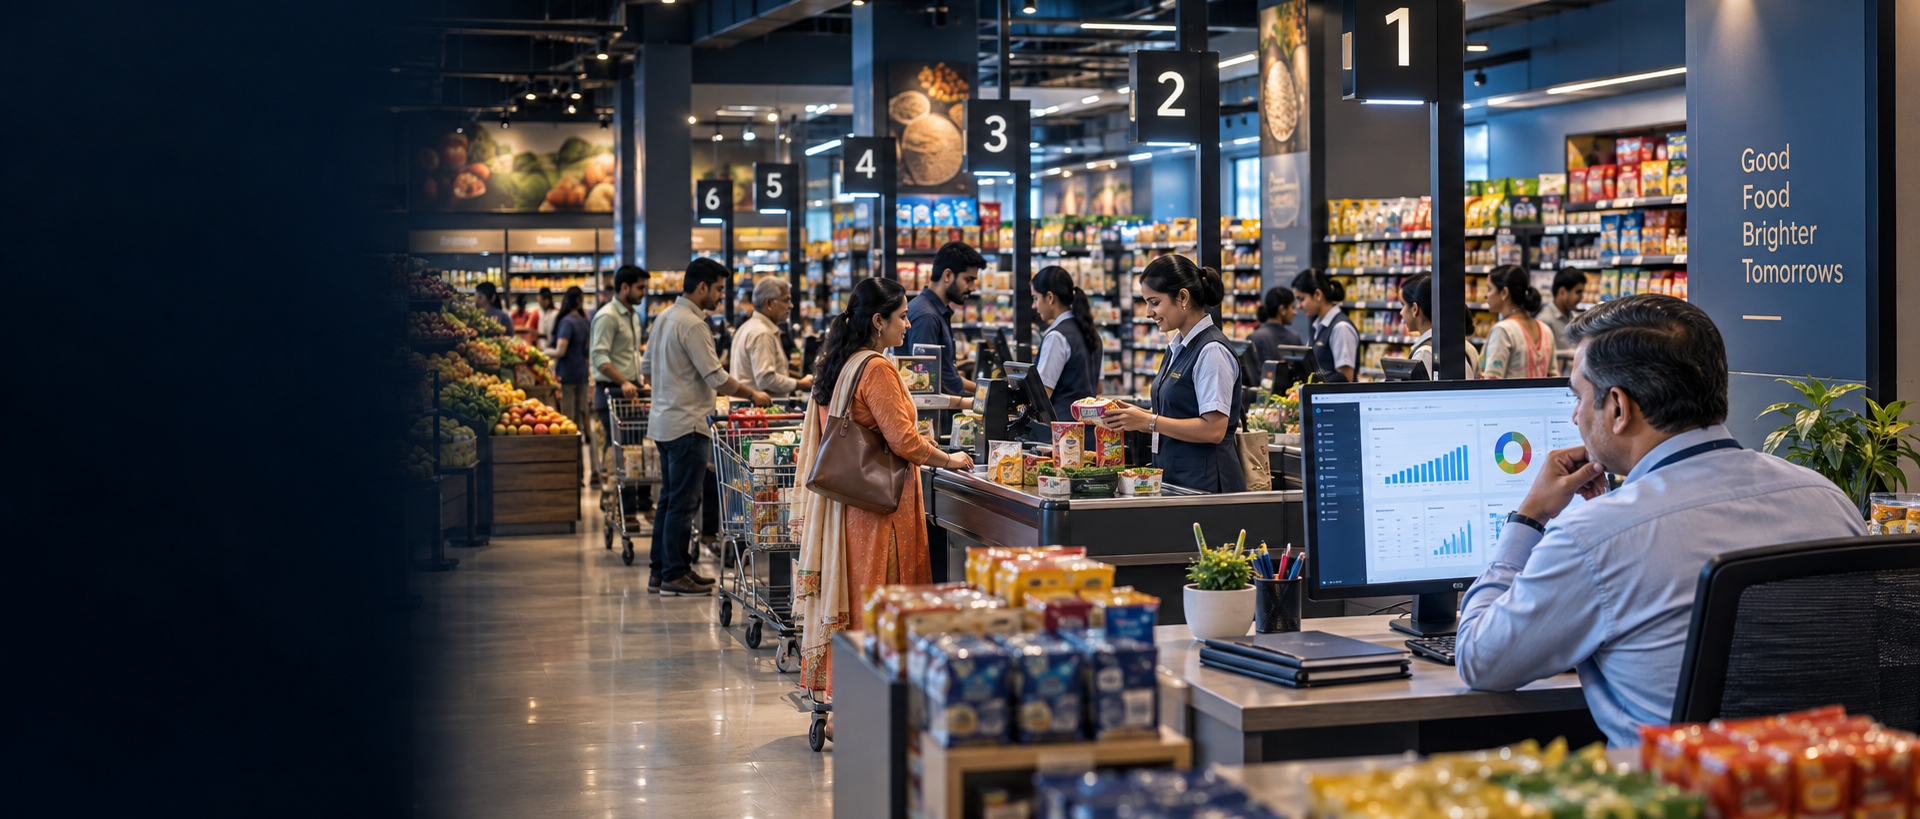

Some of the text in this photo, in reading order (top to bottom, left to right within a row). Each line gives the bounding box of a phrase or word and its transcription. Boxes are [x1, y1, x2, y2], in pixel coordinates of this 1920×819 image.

[1385, 7, 1410, 67] 1
[1157, 70, 1186, 117] 2
[983, 114, 1008, 153] 3
[855, 149, 876, 179] 4
[1741, 143, 1790, 174] Good
[705, 187, 720, 210] 6
[766, 172, 783, 198] 5
[1743, 180, 1790, 210] Food
[1743, 219, 1818, 253] Brighter
[1742, 258, 1844, 284] Tomorrows
